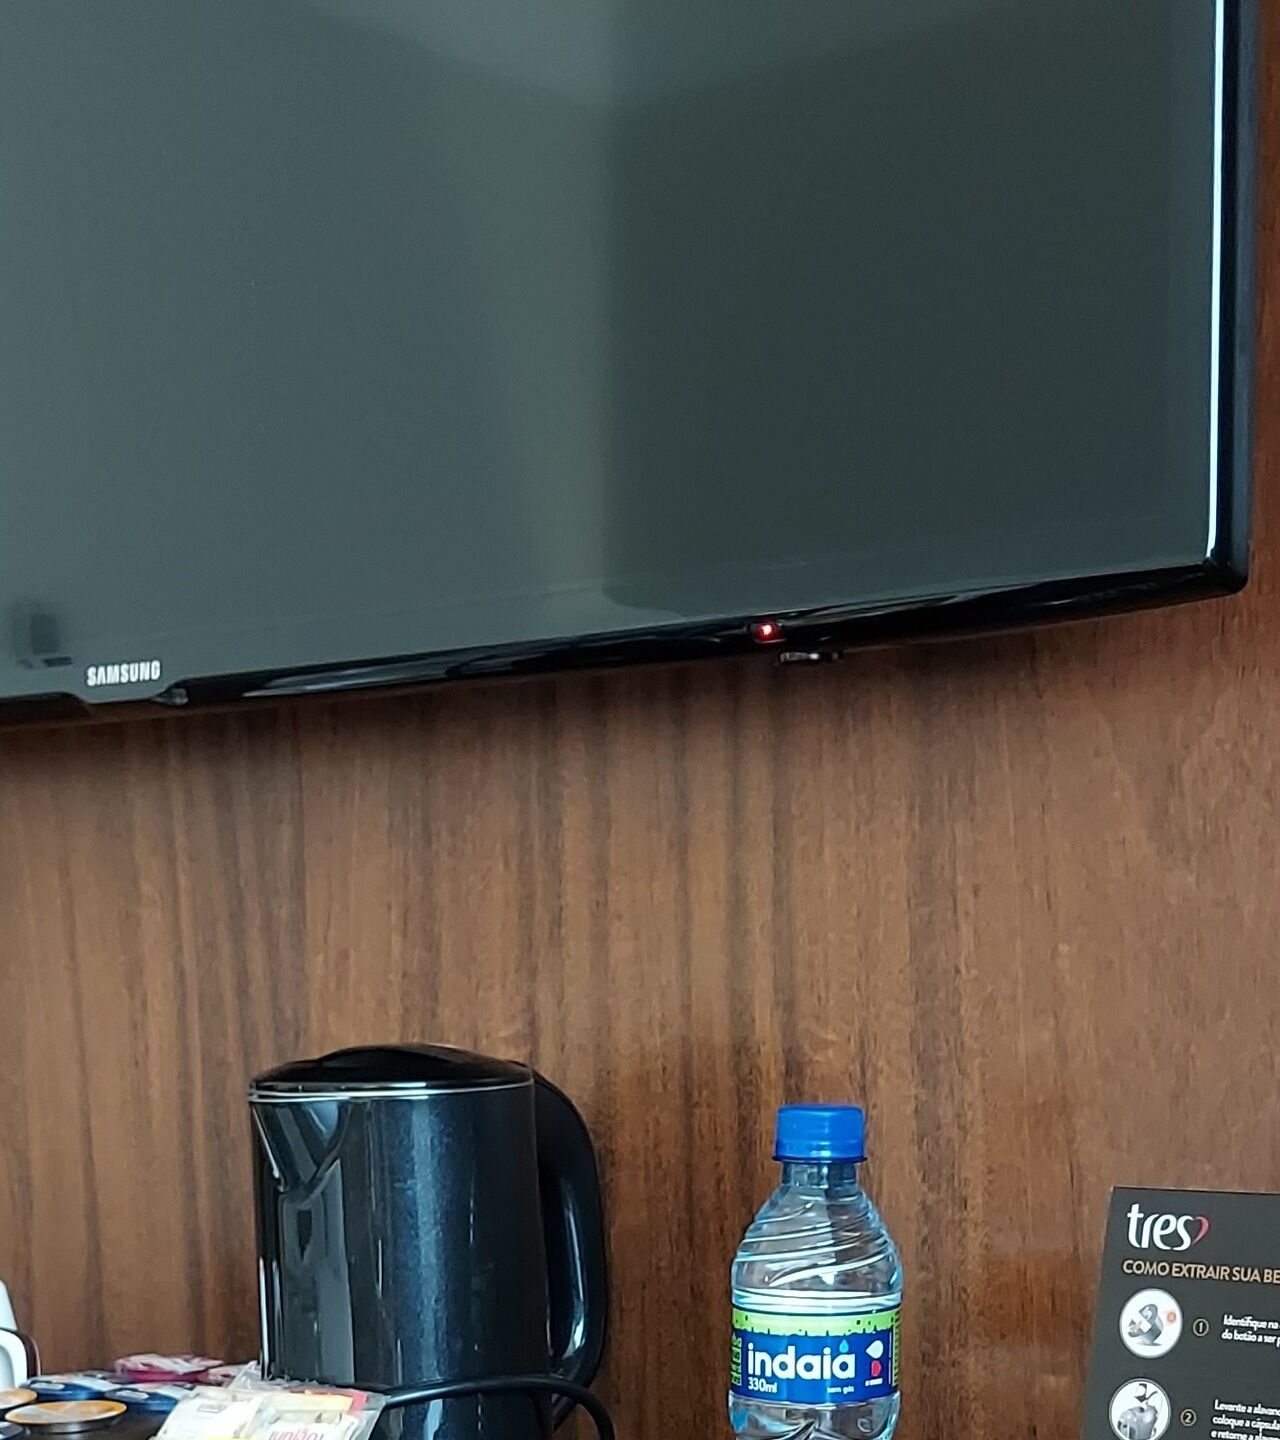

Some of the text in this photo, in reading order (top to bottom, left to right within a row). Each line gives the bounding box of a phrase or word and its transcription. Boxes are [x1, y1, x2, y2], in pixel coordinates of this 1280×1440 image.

[86, 660, 161, 686] SAMSUNG
[1127, 1203, 1194, 1251] tres
[1123, 1259, 1169, 1276] COMO
[1171, 1262, 1230, 1281] EXTRAIR
[1231, 1266, 1262, 1282] SUA
[1223, 1314, 1267, 1331] Identifique
[1268, 1321, 1278, 1329] na
[1221, 1329, 1233, 1340] do
[747, 1376, 778, 1394] 330ml
[1214, 1399, 1247, 1413] Levante
[1212, 1414, 1244, 1429] coloque
